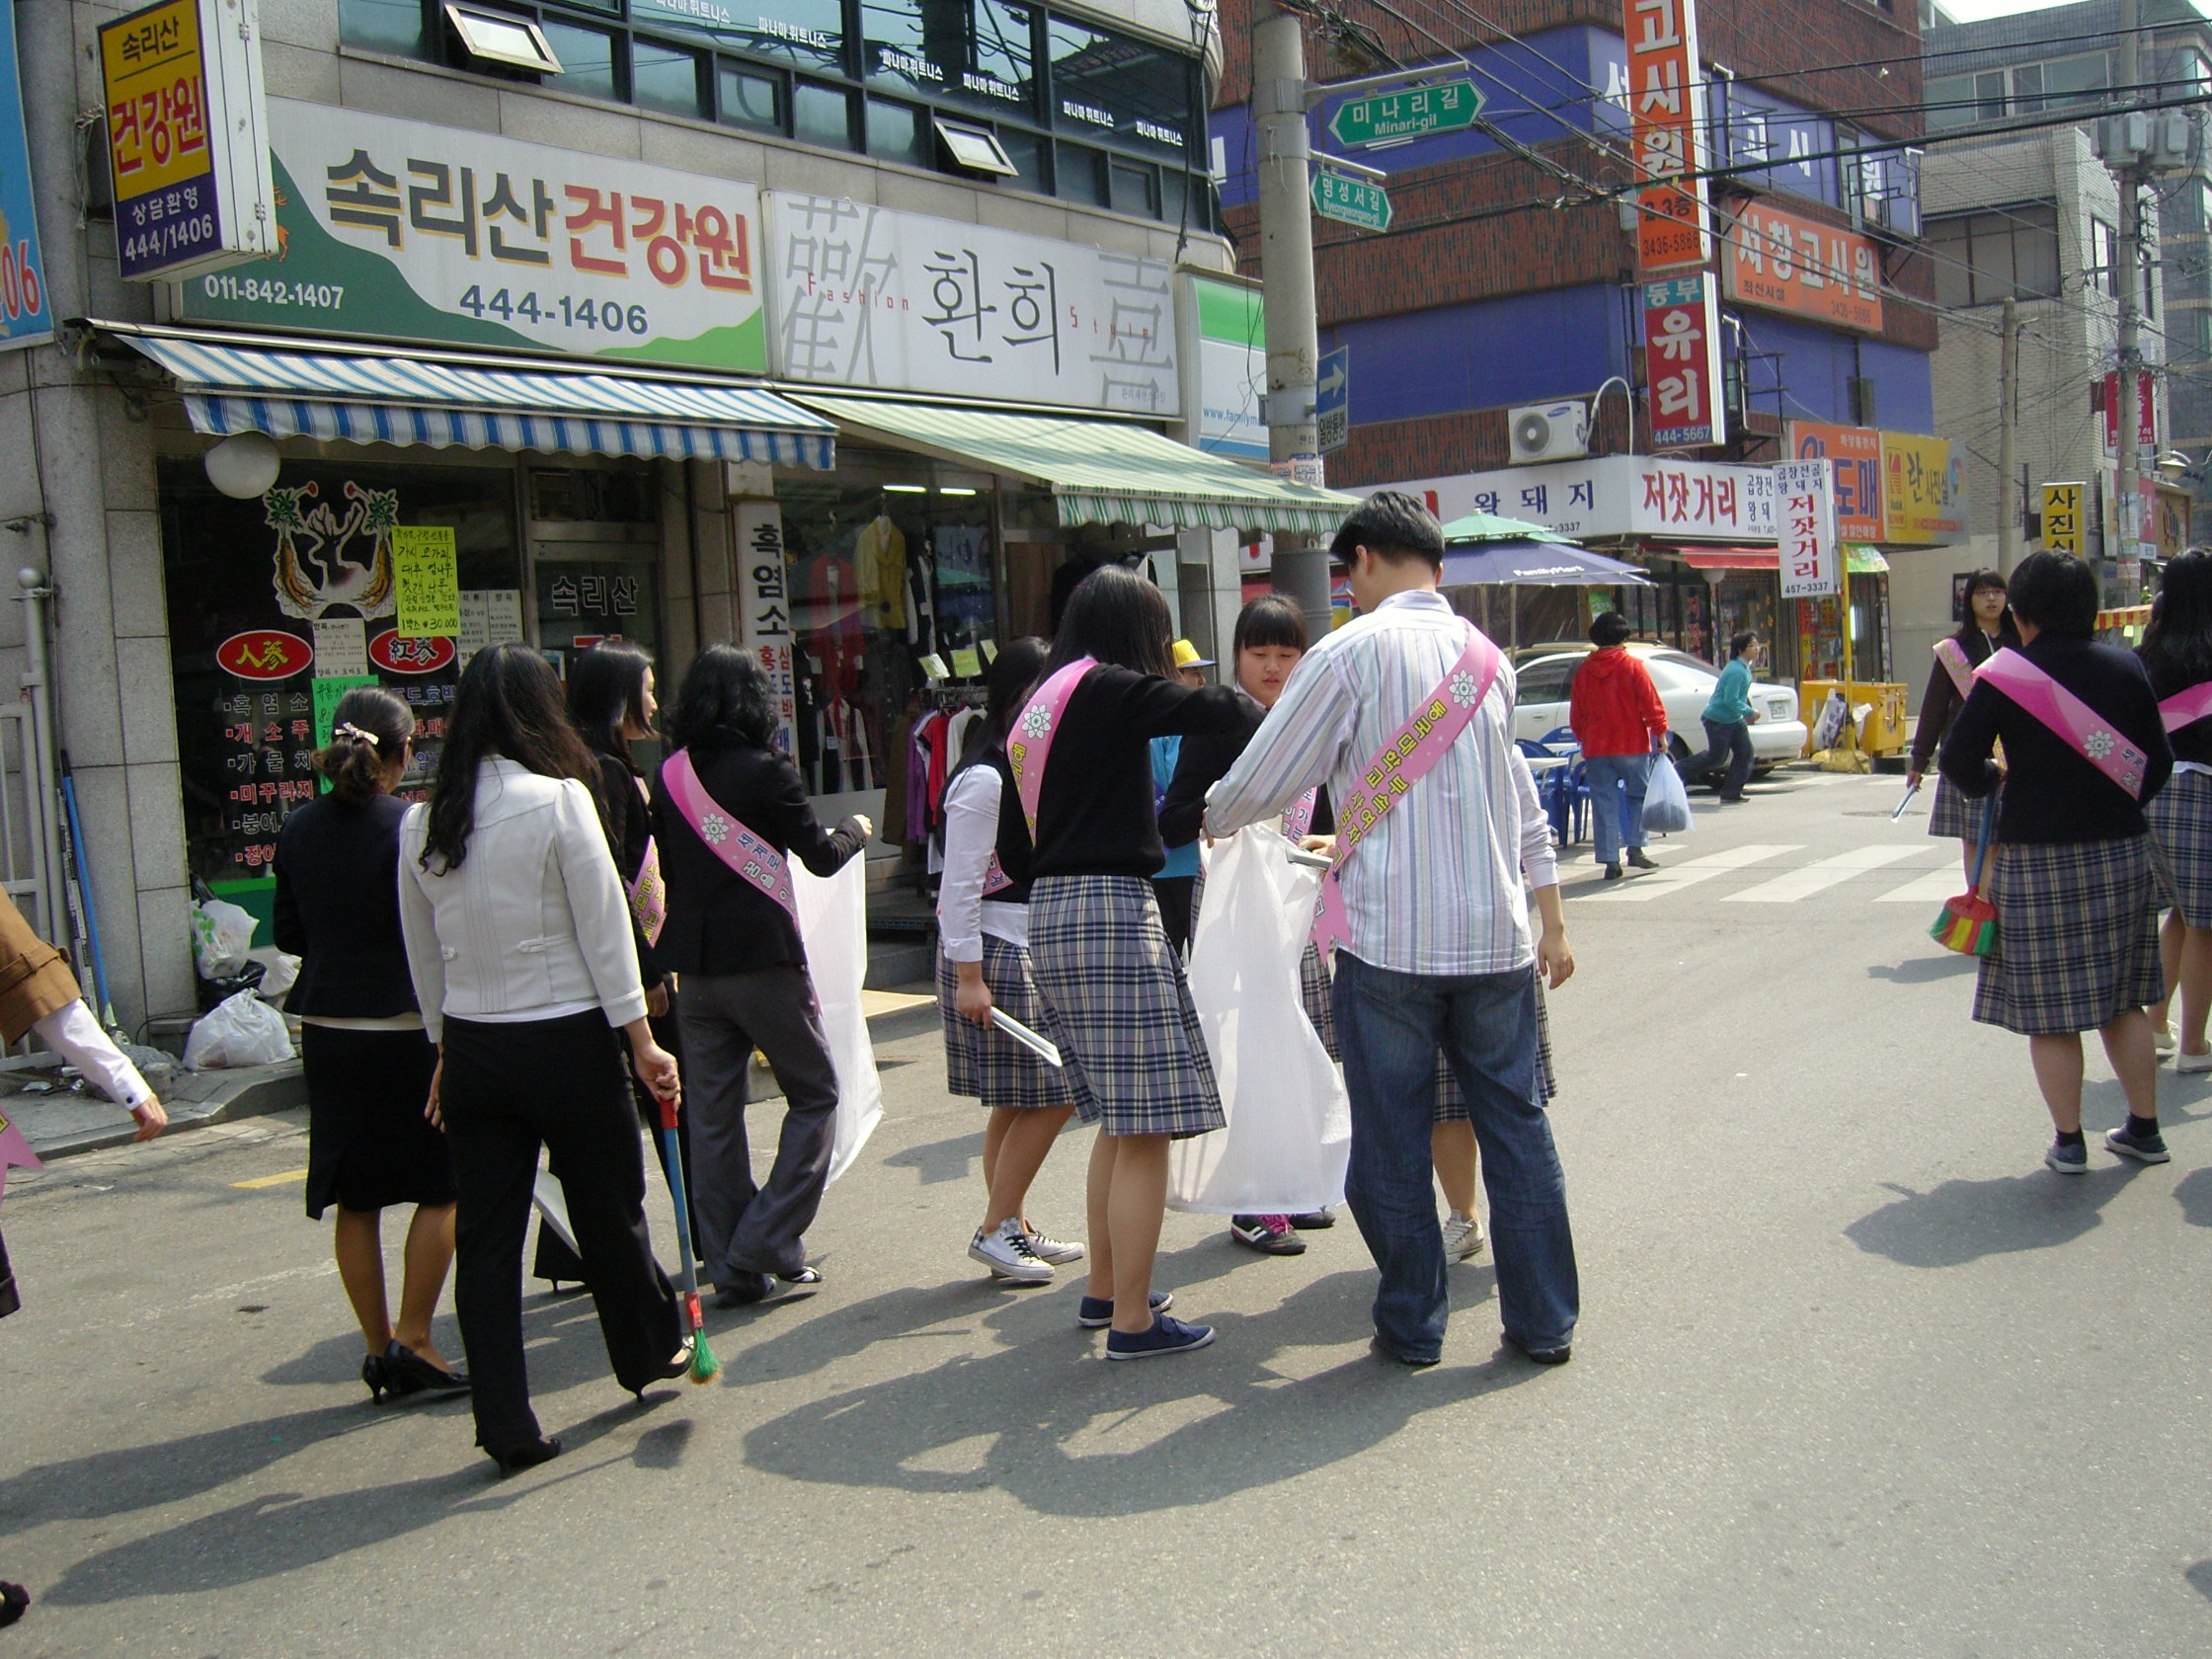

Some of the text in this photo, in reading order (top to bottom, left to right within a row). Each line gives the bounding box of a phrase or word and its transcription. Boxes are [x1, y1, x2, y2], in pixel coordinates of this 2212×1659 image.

[121, 15, 180, 62] 속리산
[1352, 86, 1460, 124] 미나리길
[1374, 114, 1438, 135] Minari-gil
[111, 76, 206, 176] 건강원
[132, 185, 199, 227] 상담환영
[124, 213, 214, 262] 444/1406
[204, 275, 345, 310] 011-842-1407
[459, 284, 649, 336] 444-1406
[806, 272, 910, 313] Fashion
[920, 247, 1061, 377] 환희
[1647, 277, 1699, 308] 동부
[1651, 309, 1701, 422] 유리
[1654, 426, 1710, 444] 444-5667
[1778, 463, 1821, 480] 곱창전골
[750, 522, 790, 637] 흑염소
[1512, 564, 1585, 577] FamilyMart
[1784, 582, 1829, 594] 457-3337
[551, 576, 638, 616] 속리산
[239, 778, 315, 805] 미꾸라지
